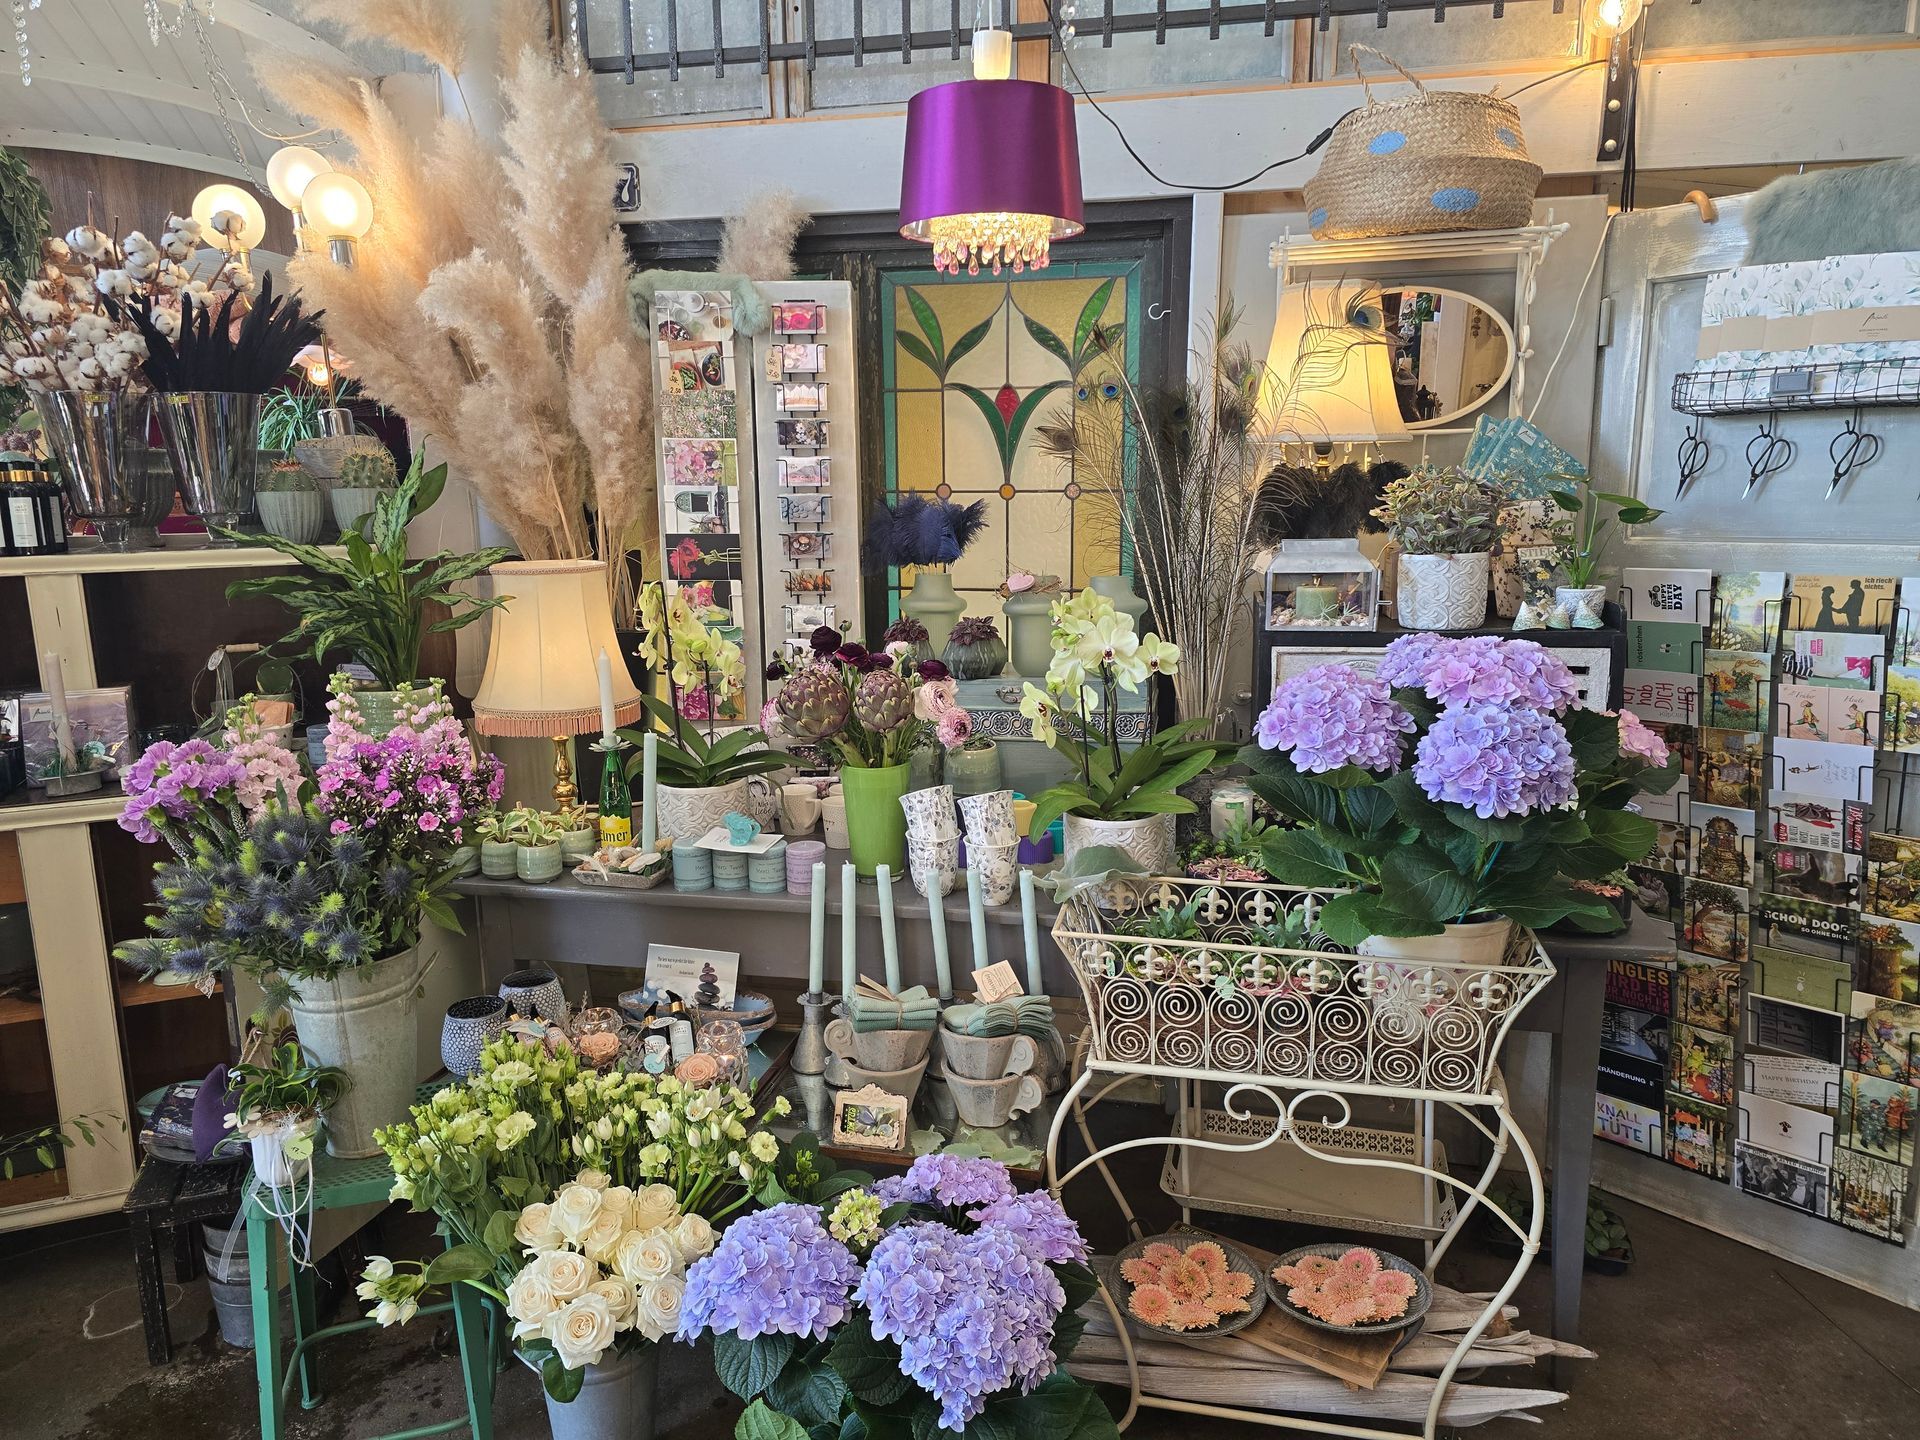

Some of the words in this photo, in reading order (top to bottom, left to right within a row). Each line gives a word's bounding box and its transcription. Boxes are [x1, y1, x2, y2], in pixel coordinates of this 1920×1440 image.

[1673, 583, 1683, 611] DAY
[1637, 684, 1654, 706] hab
[1654, 682, 1675, 711] DICH
[1677, 685, 1695, 713] LIEB
[1811, 929, 1831, 938] OHNE
[1761, 1074, 1784, 1082] HAPPY
[1784, 1076, 1819, 1085] BIRTHDAY
[1596, 1101, 1643, 1125] KNALL
[1596, 1115, 1643, 1143] TÜTE
